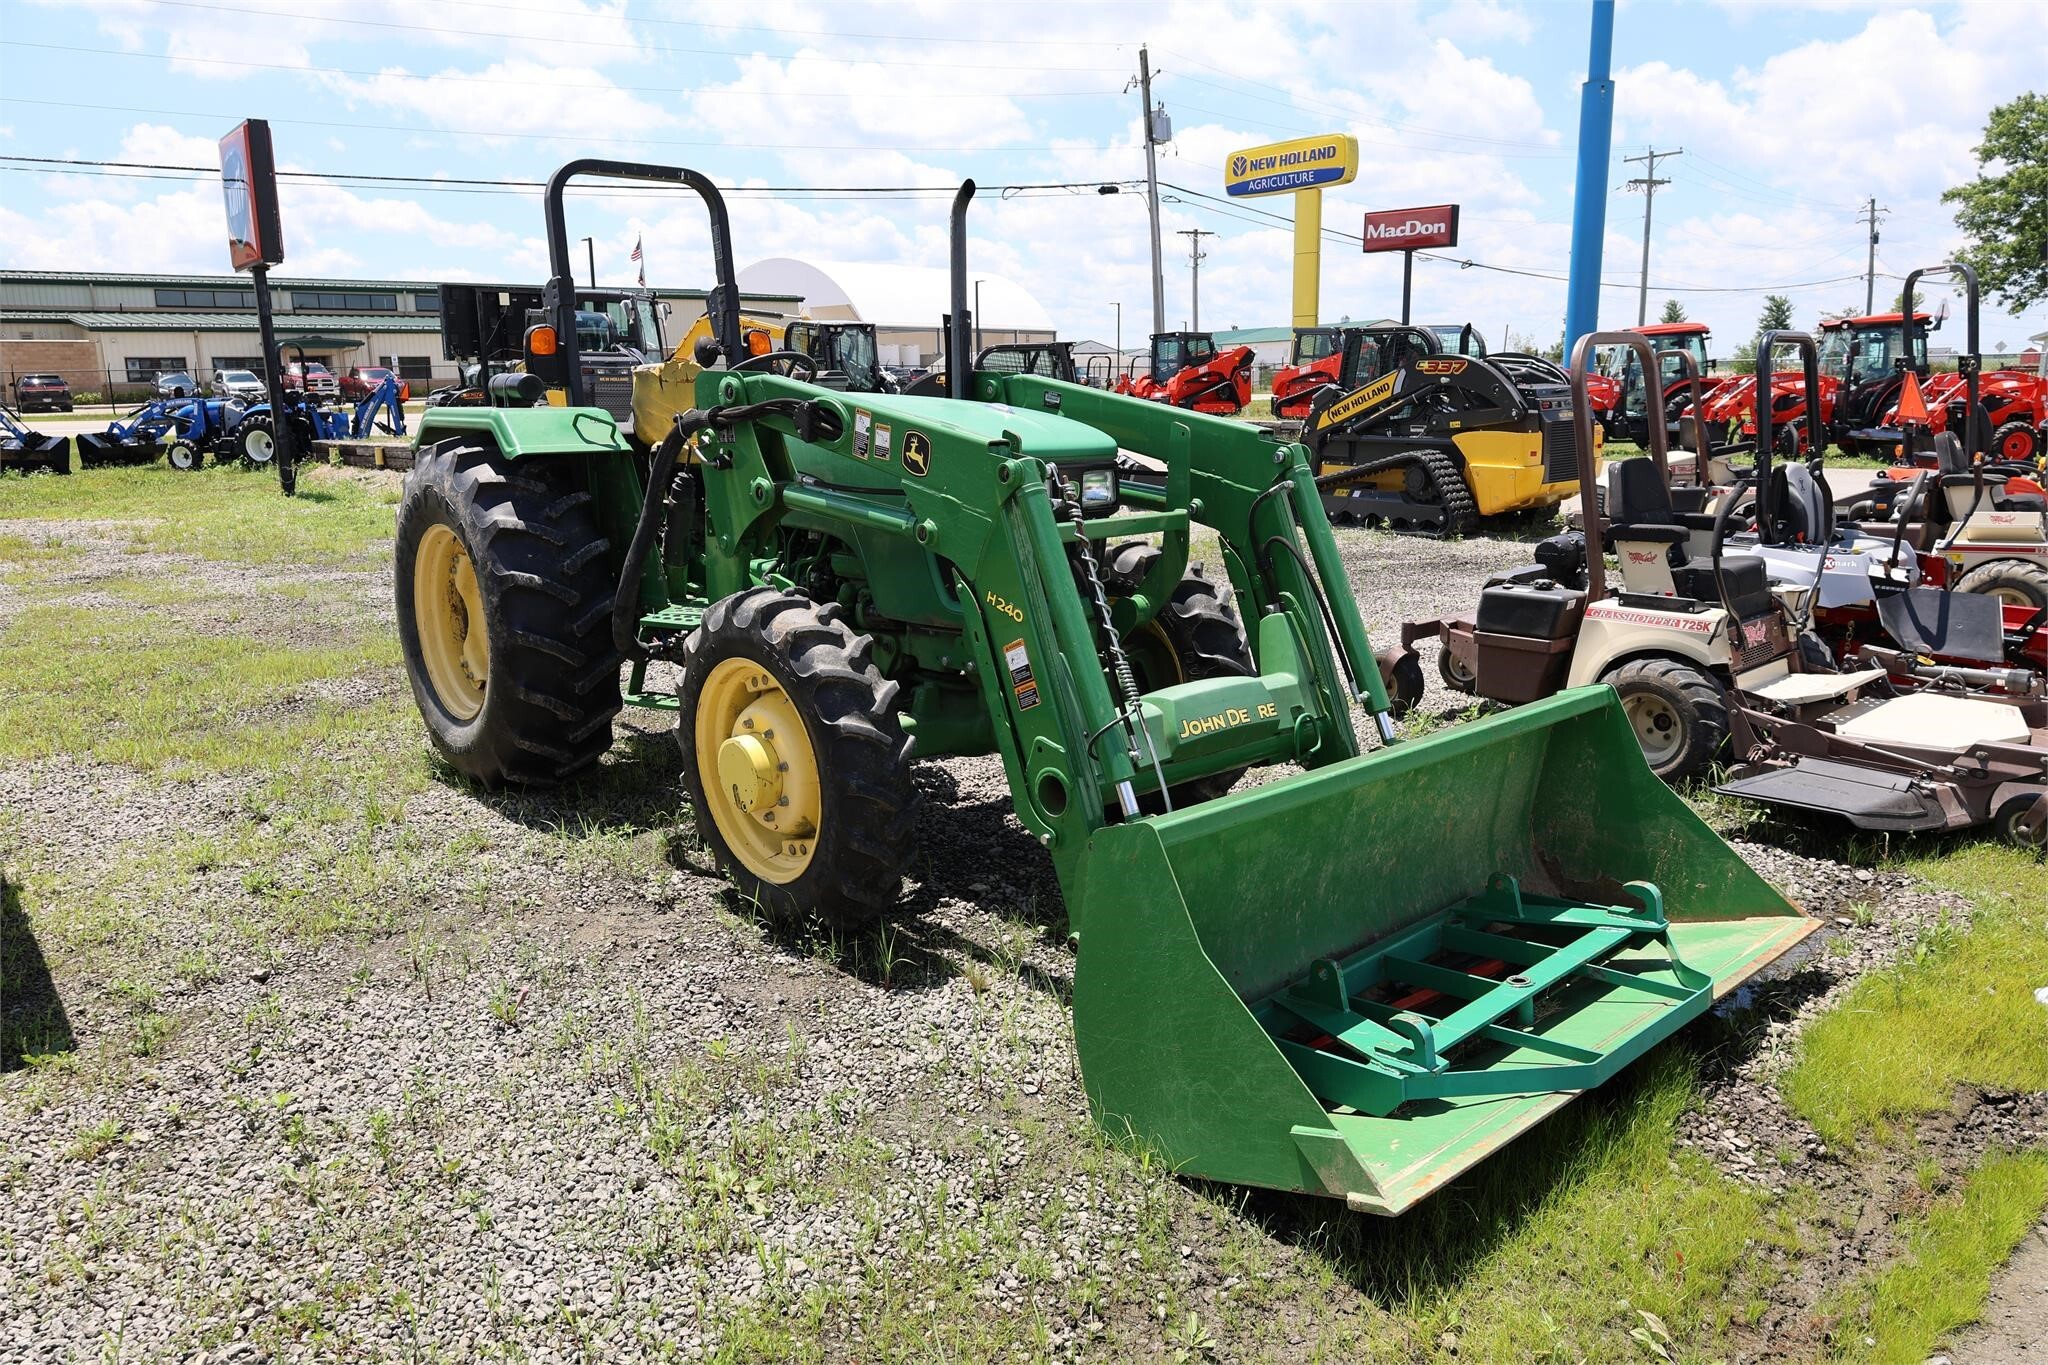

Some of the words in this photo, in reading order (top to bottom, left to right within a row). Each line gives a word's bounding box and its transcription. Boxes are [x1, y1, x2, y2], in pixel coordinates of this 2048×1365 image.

[1249, 155, 1277, 172] NEW
[1279, 145, 1336, 167] HOLLAND
[1248, 171, 1315, 192] AGRICULTURE
[1366, 220, 1446, 240] MacDon
[1330, 404, 1351, 419] NEW
[1351, 382, 1390, 409] HOLLAND
[986, 591, 1024, 622] H240
[1590, 608, 1678, 628] GRASSHOPPER
[1681, 620, 1712, 632] 725K
[1180, 713, 1227, 739] JOHN
